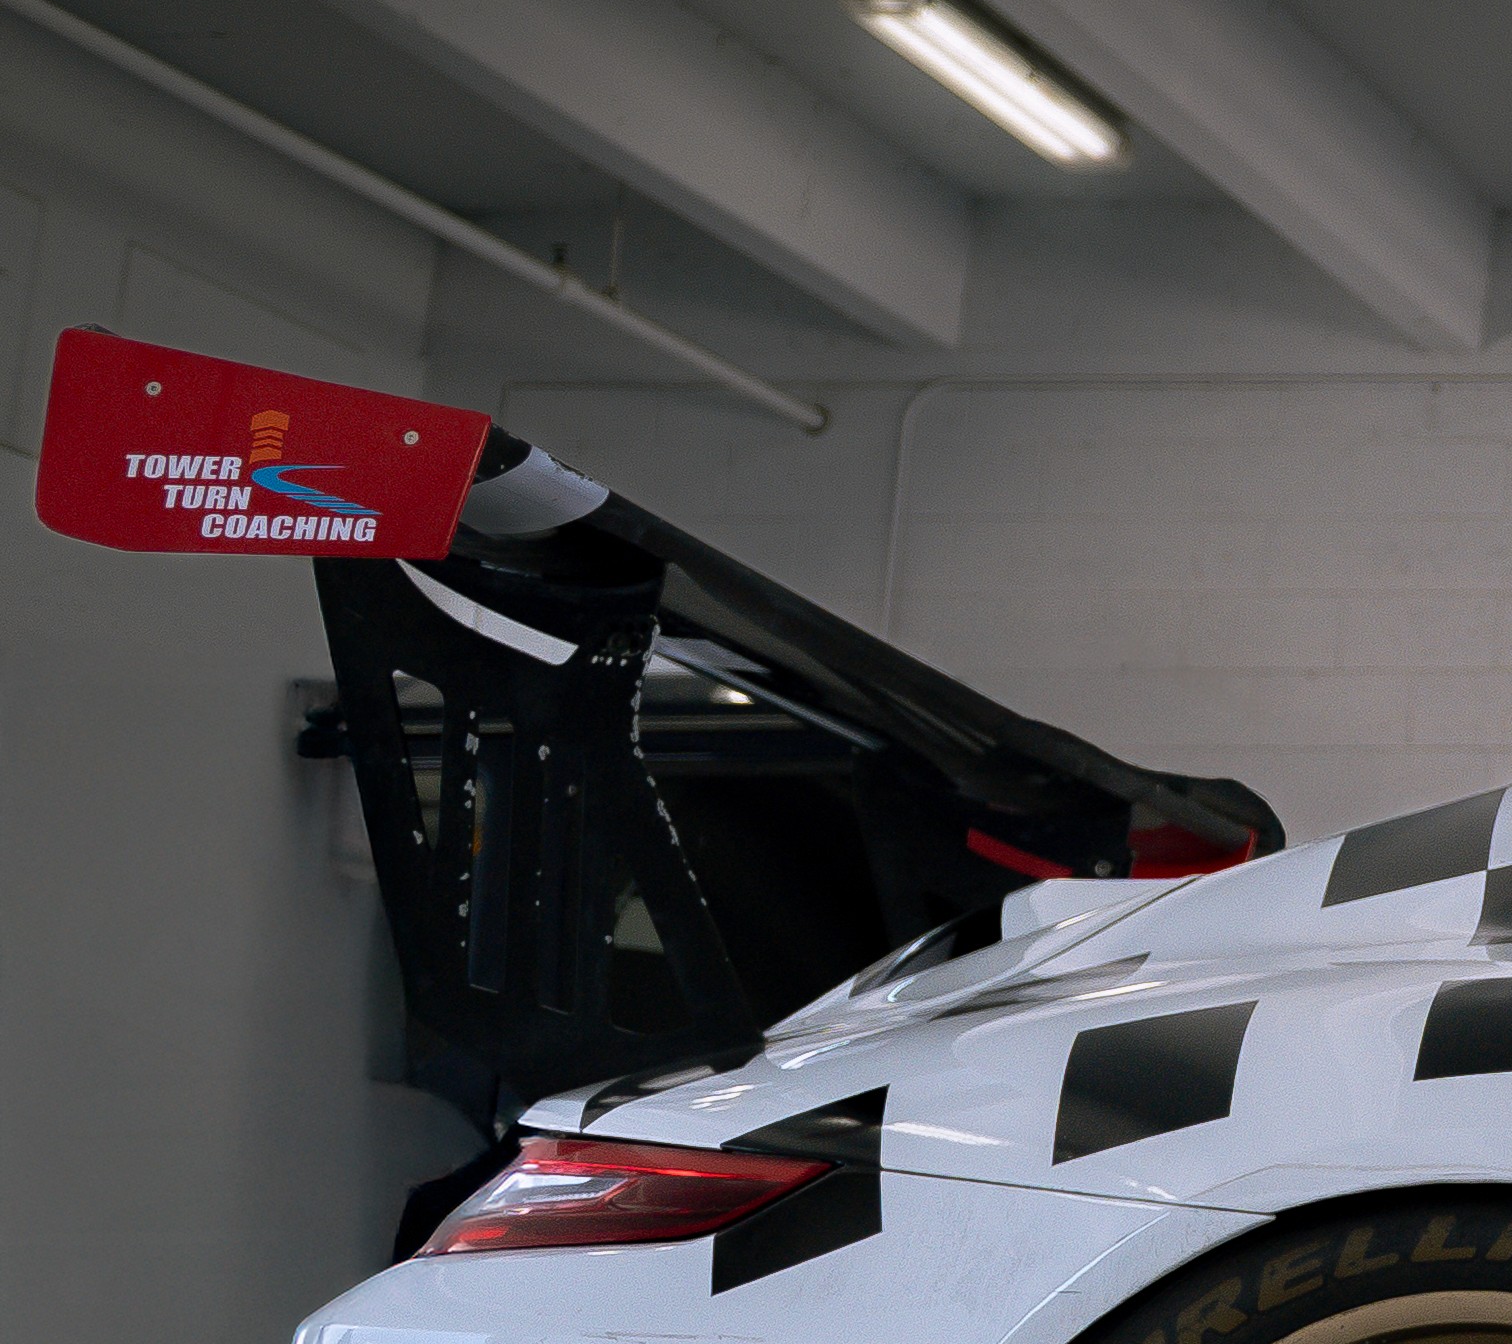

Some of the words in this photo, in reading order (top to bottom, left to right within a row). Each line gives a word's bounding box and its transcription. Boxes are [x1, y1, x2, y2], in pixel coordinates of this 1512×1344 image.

[126, 454, 242, 480] TOWER
[164, 485, 251, 509] TURN
[201, 514, 376, 541] COACHING
